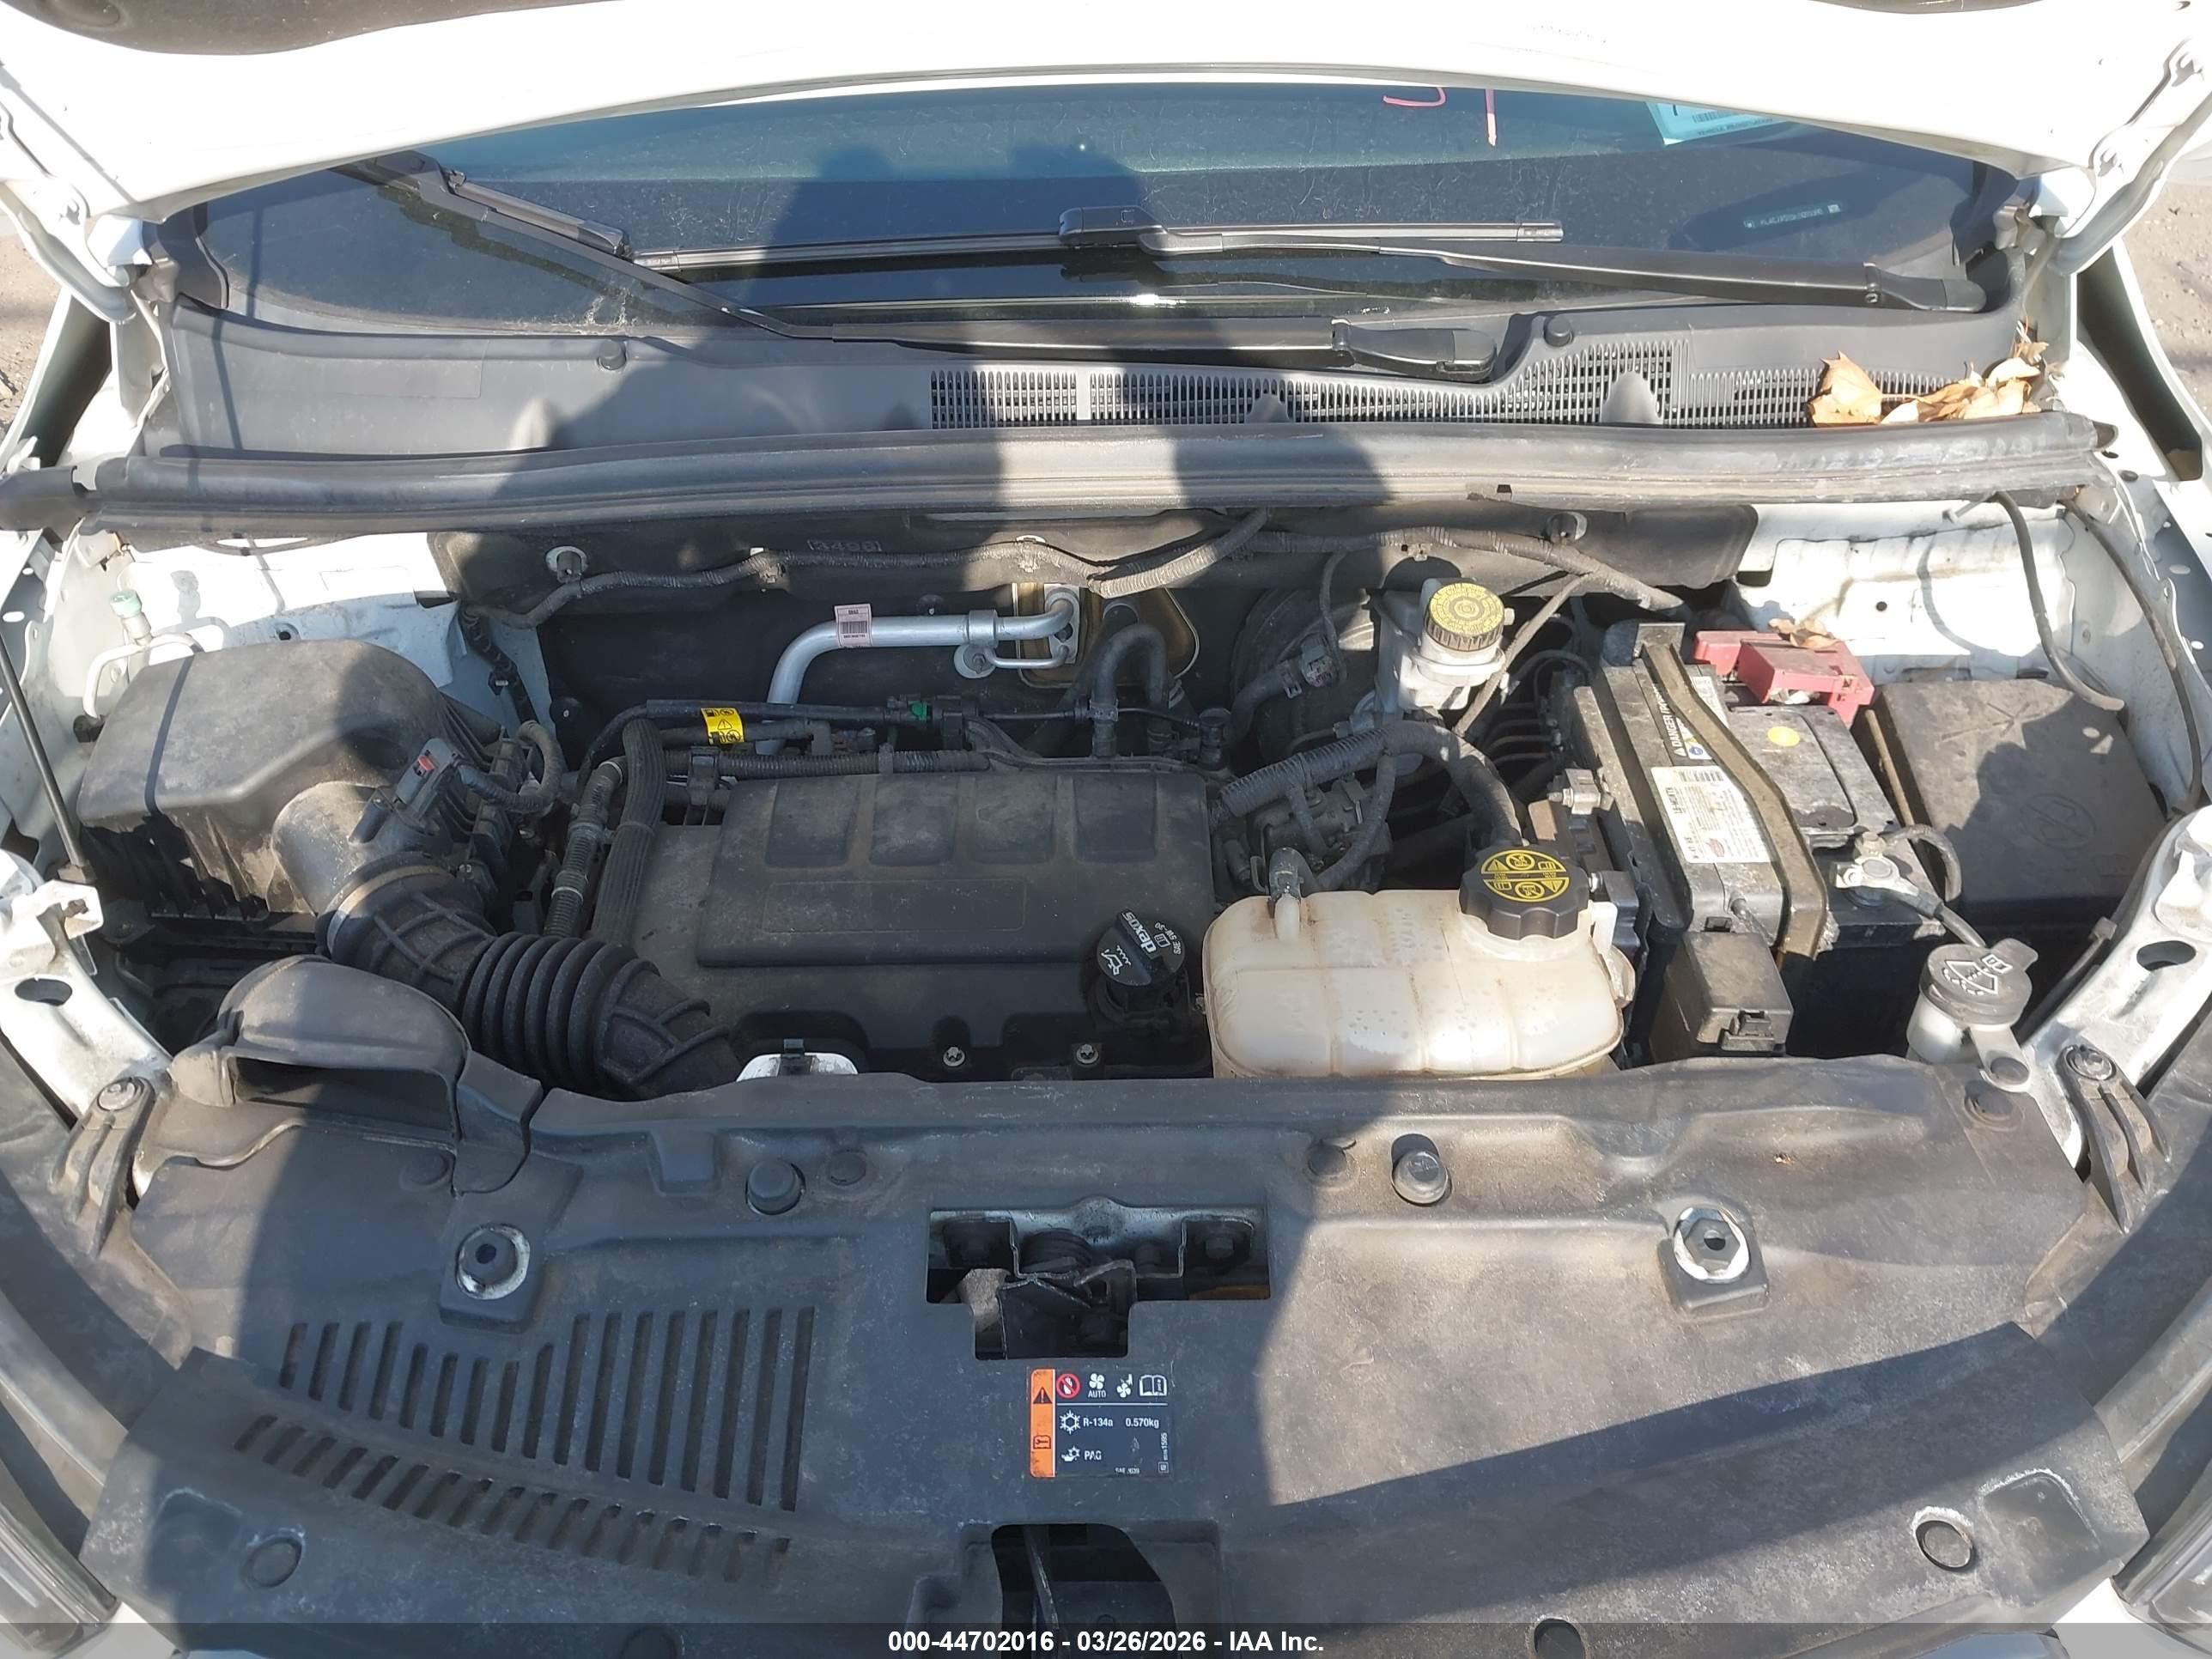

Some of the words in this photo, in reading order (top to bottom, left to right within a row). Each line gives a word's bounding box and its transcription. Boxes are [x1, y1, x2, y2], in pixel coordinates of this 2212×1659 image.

[1121, 911, 1157, 953] dexos
[1154, 921, 1177, 941] 5W-30
[1173, 940, 1182, 955] SAE
[1088, 1390, 1107, 1399] AUTO
[1083, 1417, 1114, 1427] R-134a
[1126, 1418, 1159, 1429] 0.570kg
[1084, 1450, 1103, 1461] PAG
